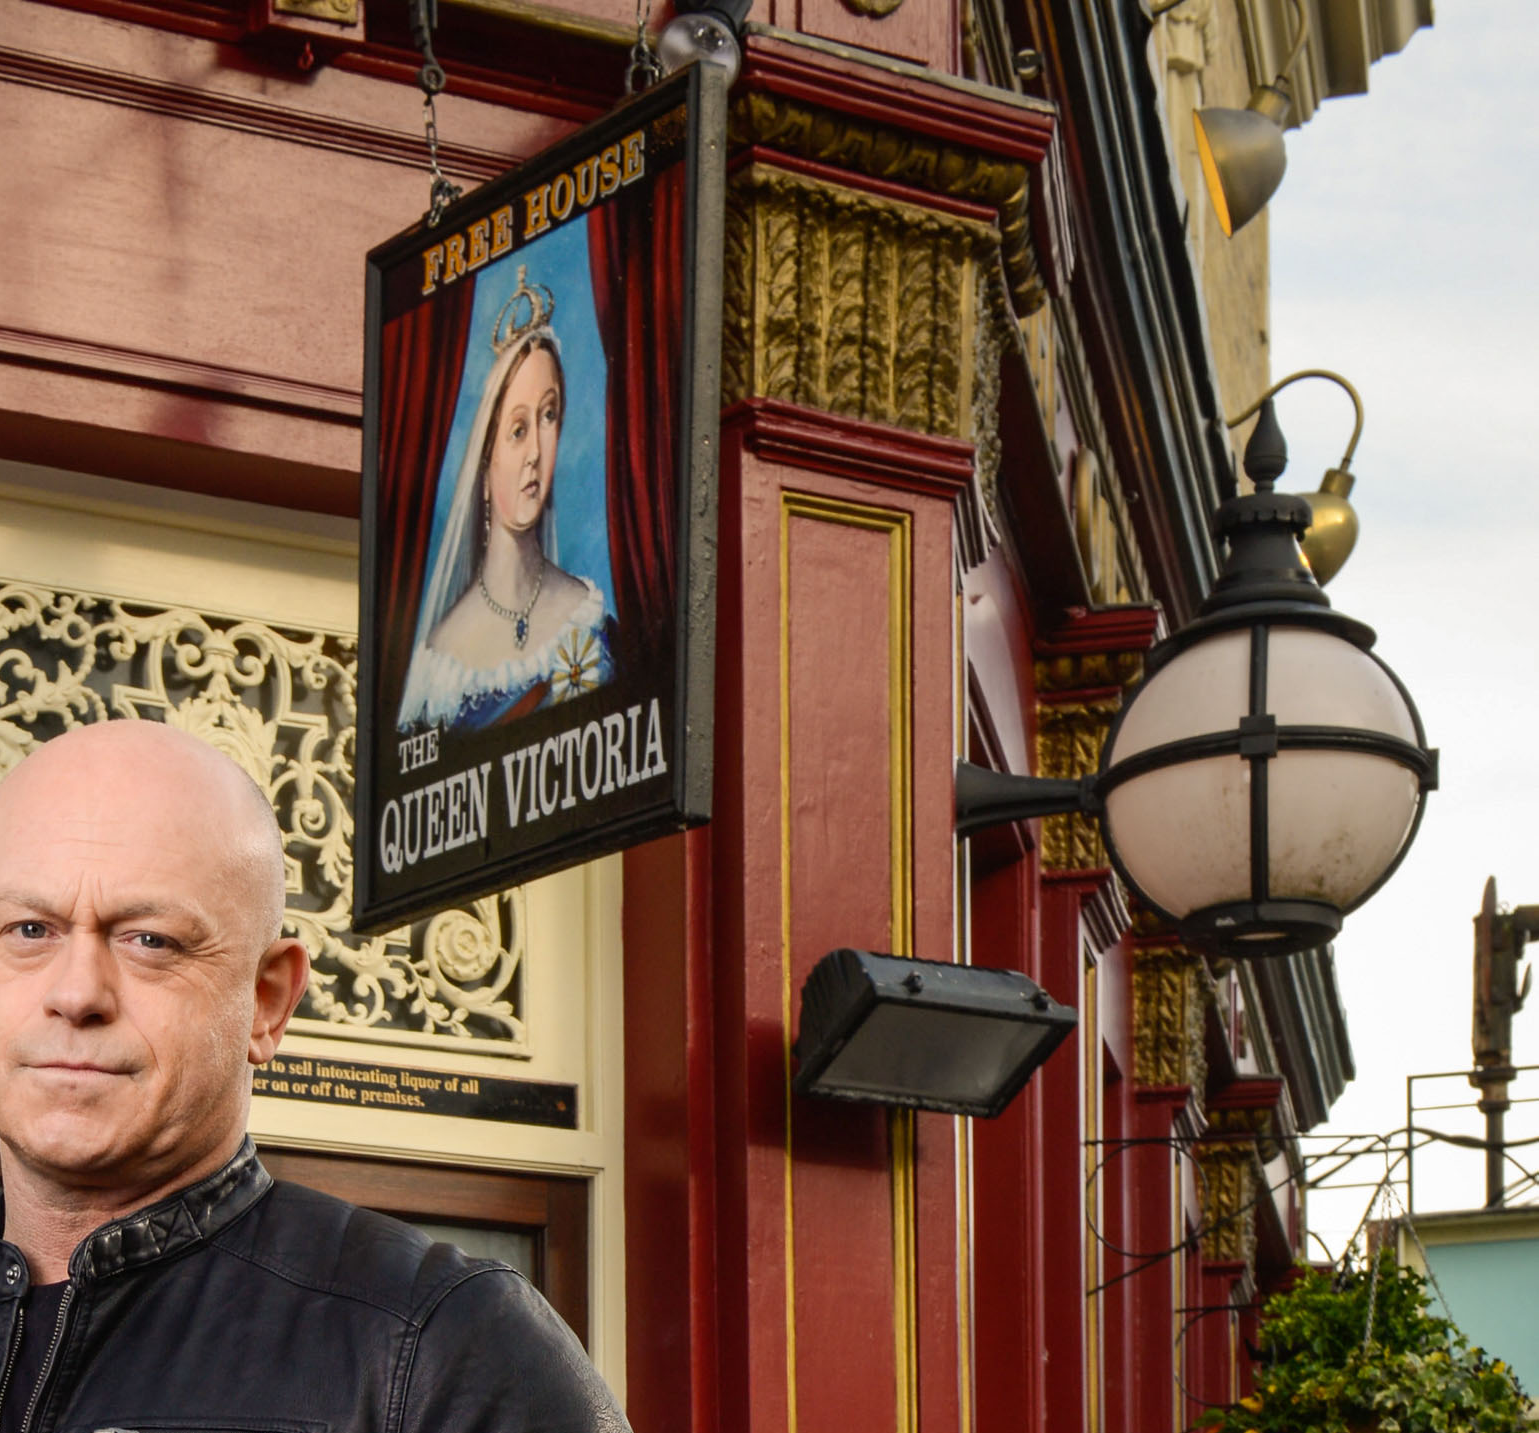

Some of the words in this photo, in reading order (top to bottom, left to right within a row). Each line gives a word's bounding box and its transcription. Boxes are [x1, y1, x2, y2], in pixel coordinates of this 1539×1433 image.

[421, 205, 514, 296] FREE
[524, 130, 646, 240] HOUSE
[398, 728, 439, 774] THE
[379, 762, 492, 874] QUEEN
[502, 697, 668, 828] VICTORIA
[271, 1059, 286, 1073] to
[288, 1061, 313, 1077] sell
[316, 1063, 398, 1088] intoxicating
[400, 1072, 441, 1092] liquor
[444, 1078, 460, 1093] of
[461, 1080, 480, 1095] all
[271, 1079, 290, 1094] on
[292, 1082, 309, 1095] or
[311, 1082, 333, 1098] off
[334, 1084, 357, 1100] the
[361, 1090, 426, 1108] premises.
